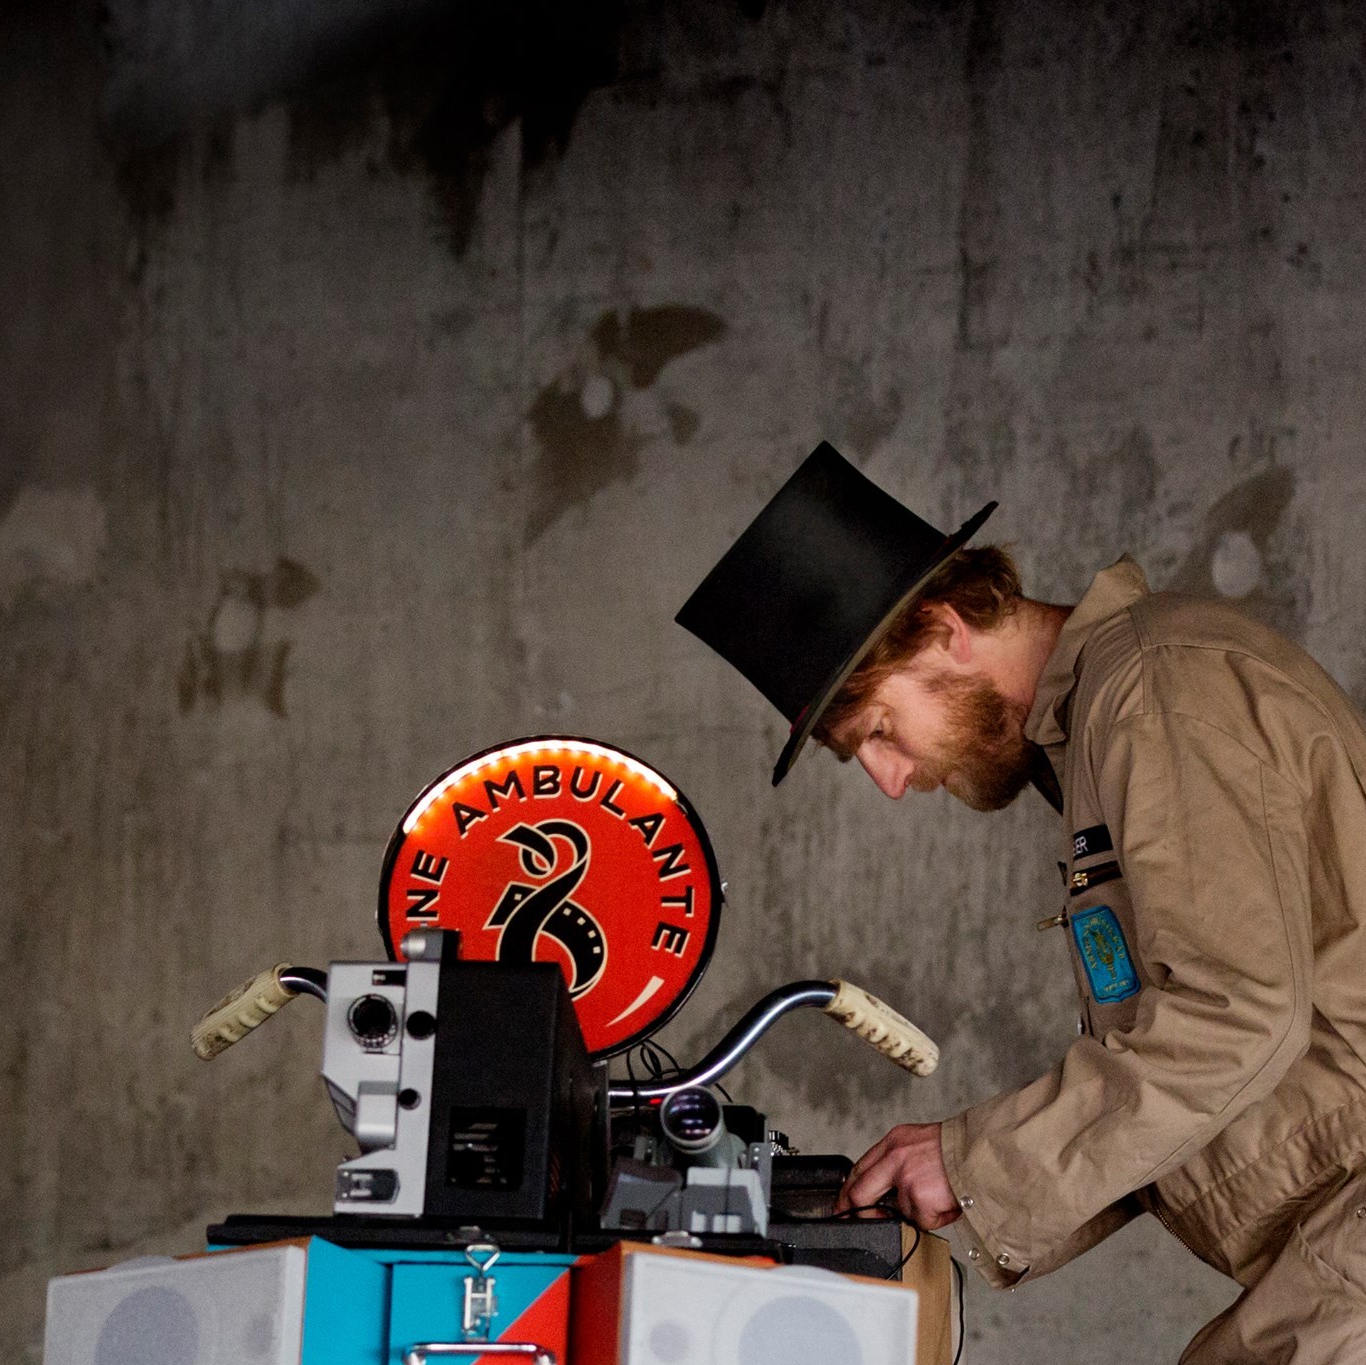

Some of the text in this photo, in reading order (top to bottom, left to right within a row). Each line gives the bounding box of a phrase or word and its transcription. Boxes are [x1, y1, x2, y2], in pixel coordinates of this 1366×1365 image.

[405, 764, 695, 958] NE AMBULANTE
[1073, 836, 1089, 856] ER
